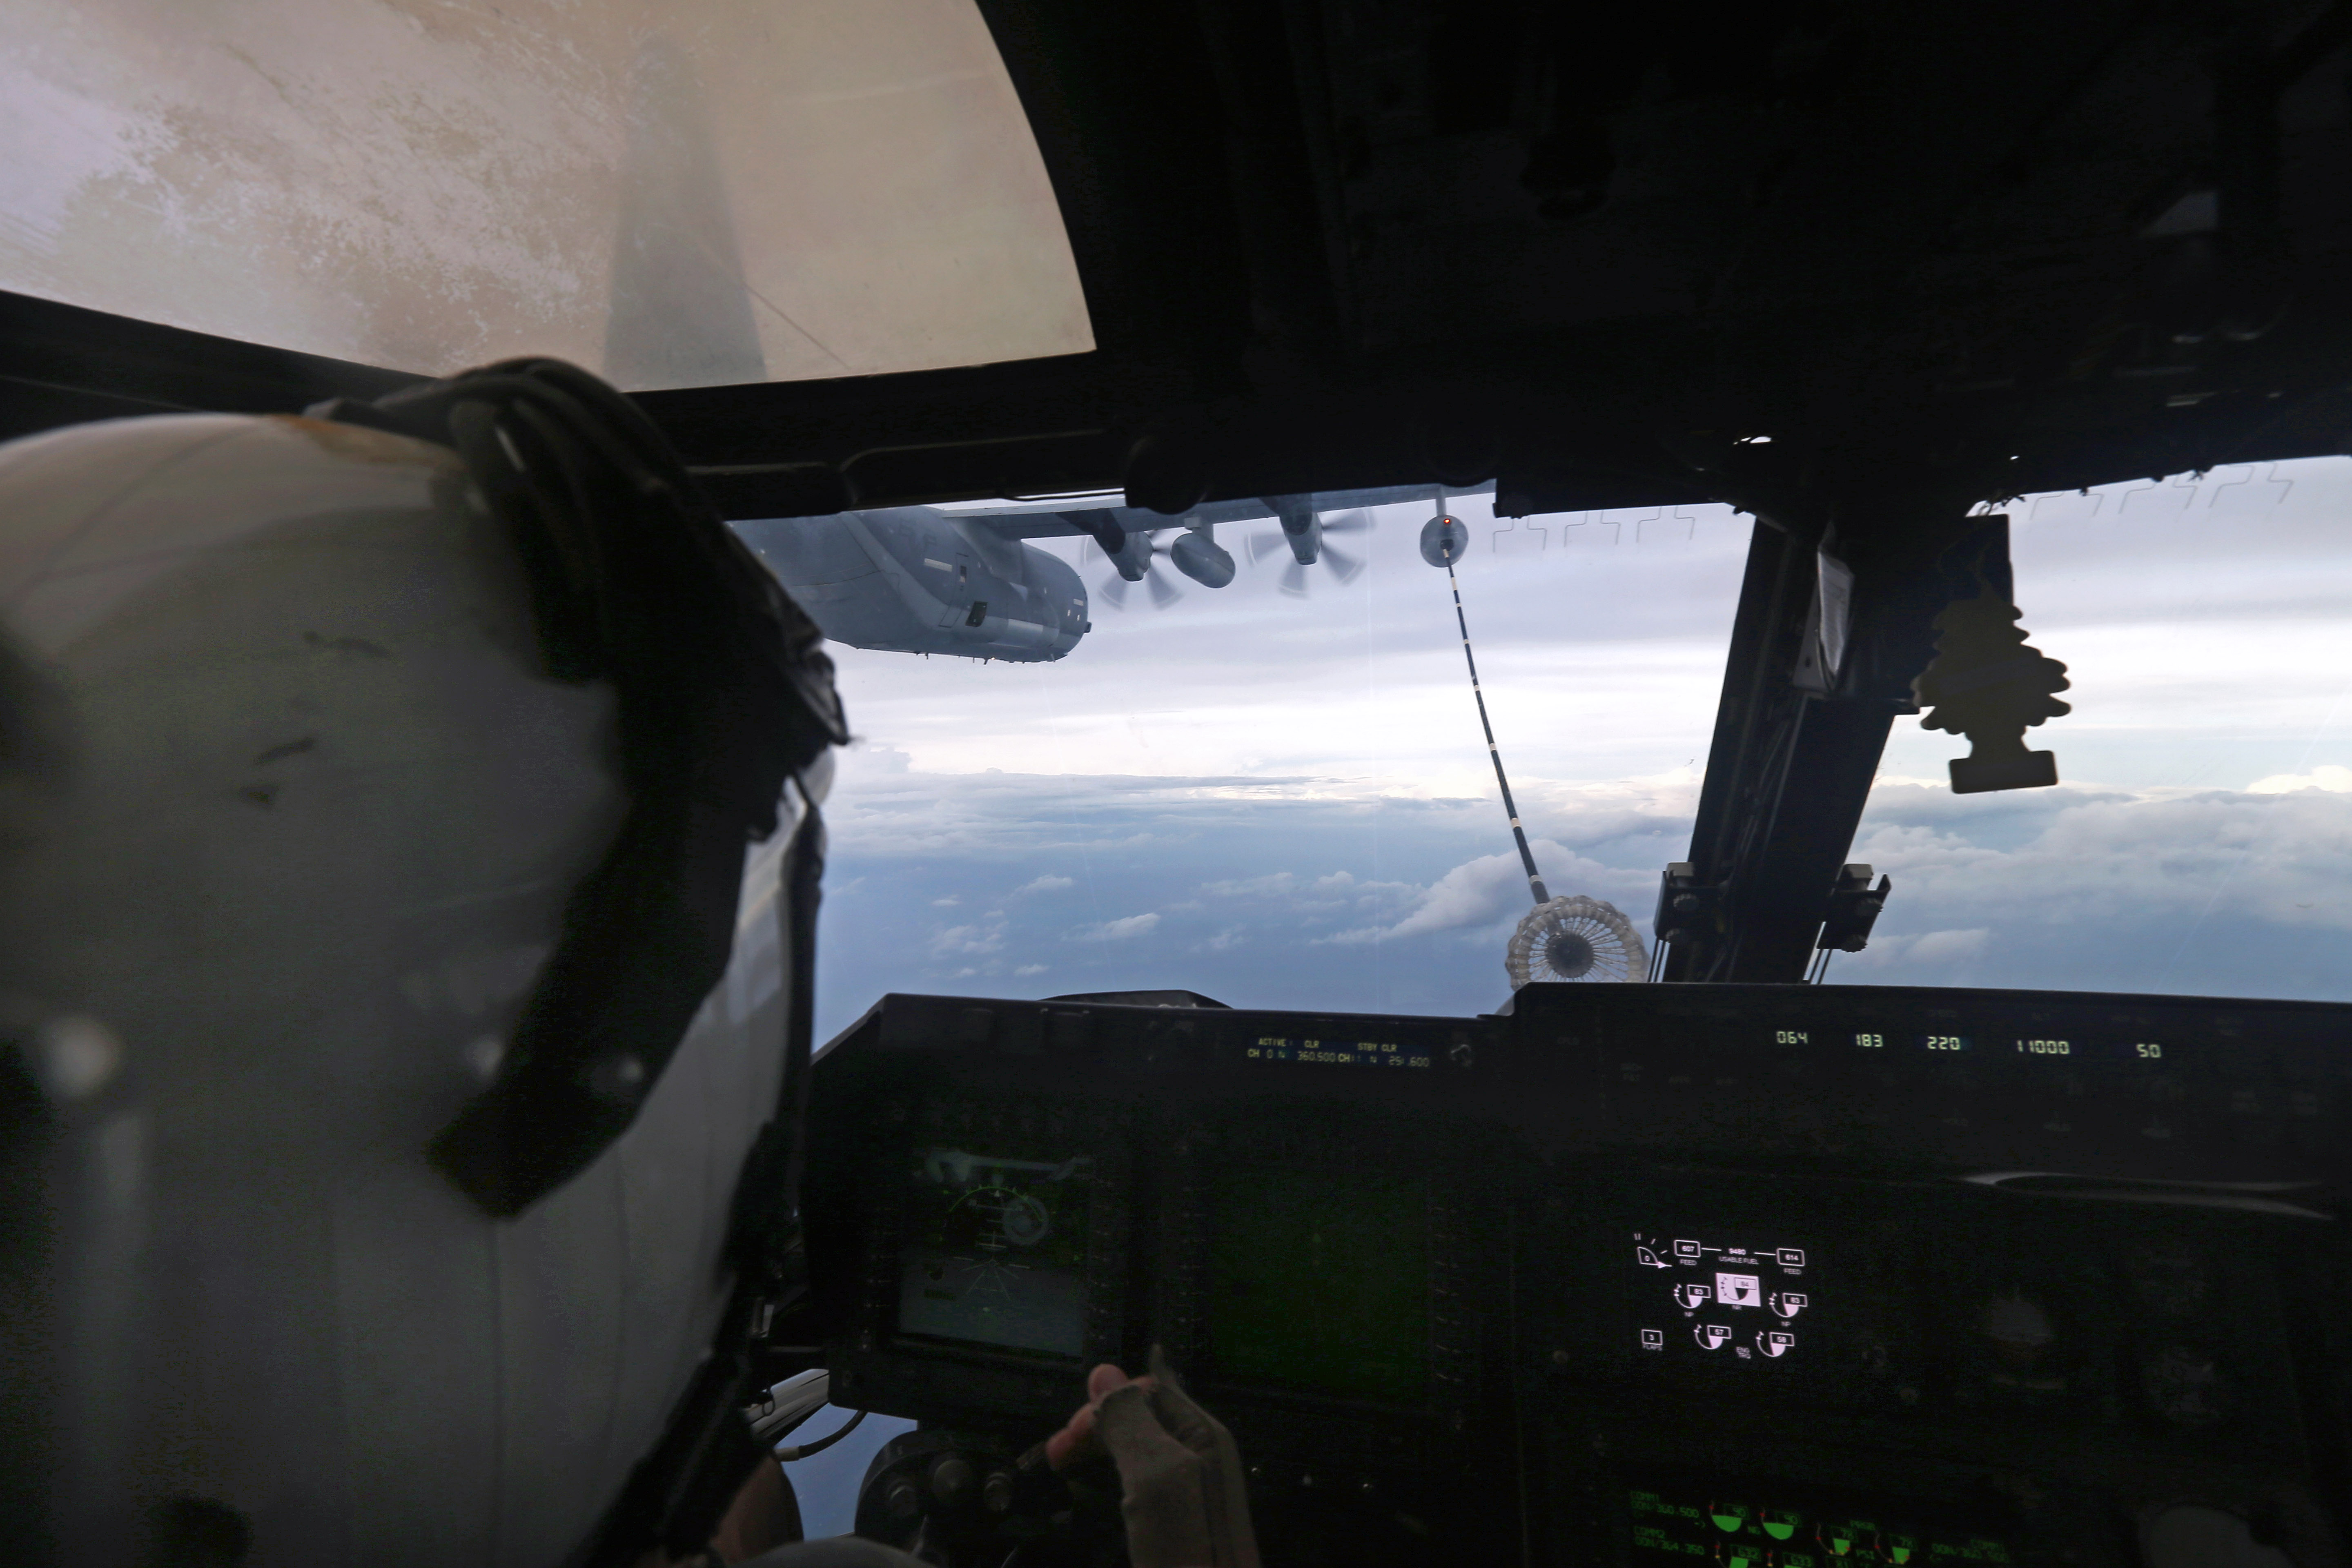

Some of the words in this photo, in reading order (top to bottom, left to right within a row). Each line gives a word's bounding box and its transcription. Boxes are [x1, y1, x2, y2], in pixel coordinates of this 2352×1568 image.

[1258, 1038, 1287, 1047] ACTIVE
[1304, 1040, 1320, 1048] CLR
[1776, 1031, 1808, 1044] 064
[1856, 1034, 1883, 1047] 183
[1927, 1036, 1960, 1051] 220
[1247, 1048, 1260, 1058] CH
[1357, 1042, 1378, 1051] STBY
[1381, 1044, 1397, 1052] CLR
[2017, 1040, 2069, 1055] 11000
[2136, 1044, 2161, 1058] 50
